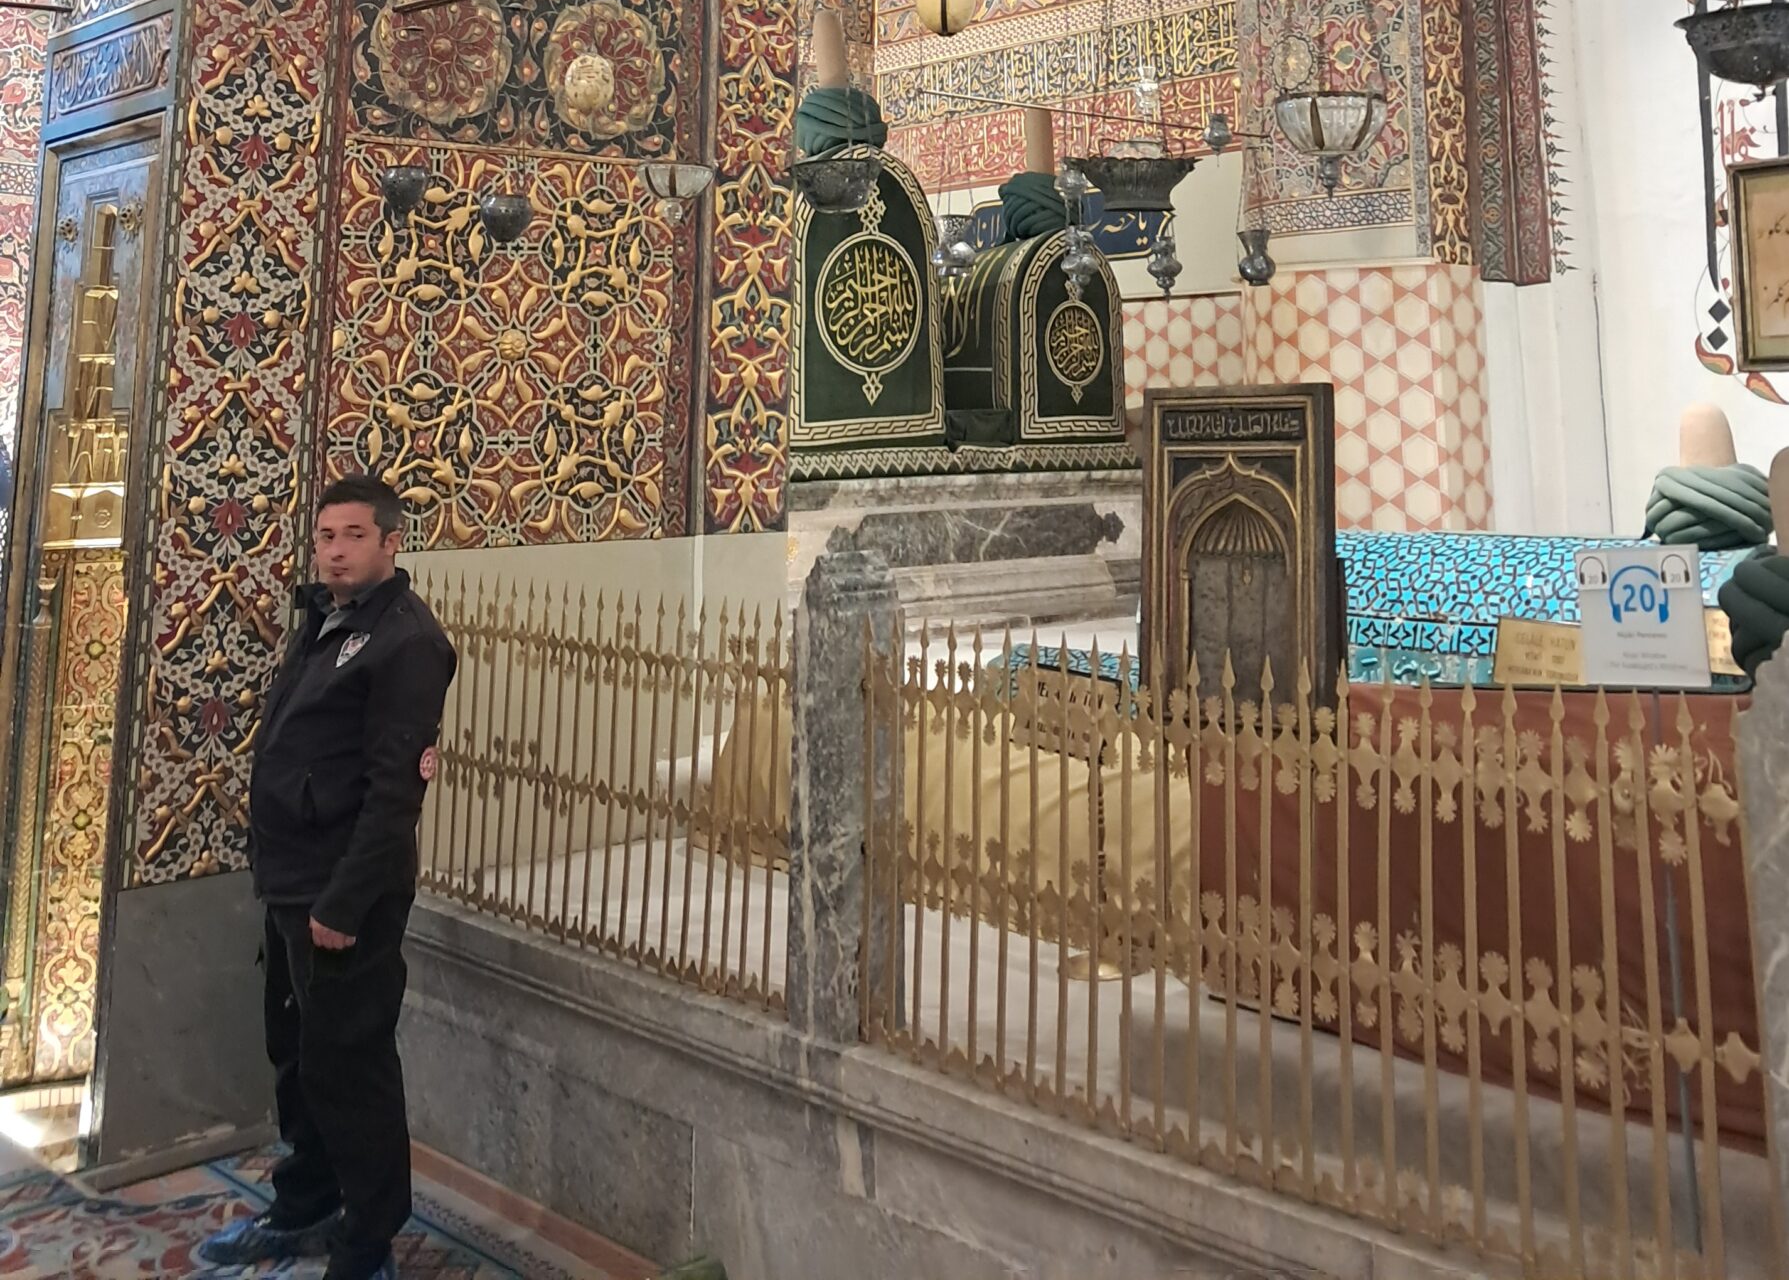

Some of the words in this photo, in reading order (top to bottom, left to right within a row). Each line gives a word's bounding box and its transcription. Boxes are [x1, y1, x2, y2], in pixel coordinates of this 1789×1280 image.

[1588, 574, 1599, 584] 20
[1670, 573, 1681, 583] 20
[1622, 584, 1655, 612] 20
